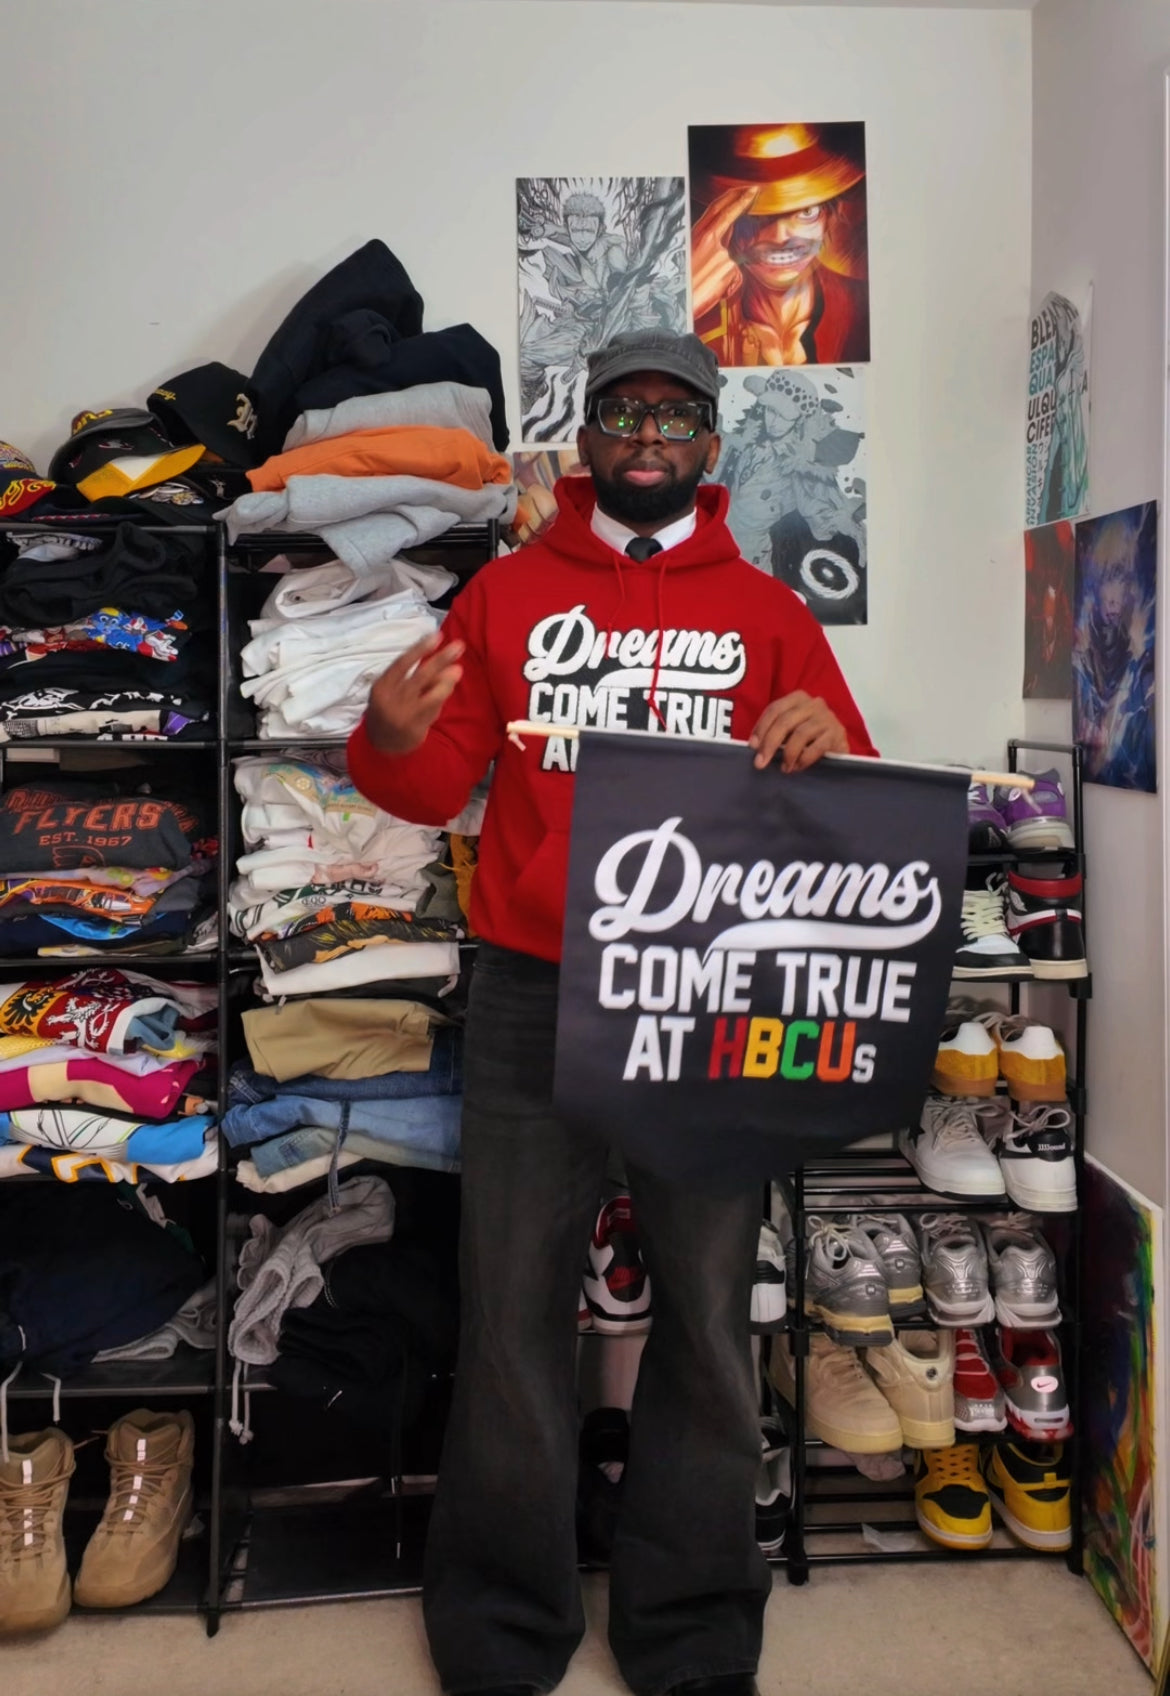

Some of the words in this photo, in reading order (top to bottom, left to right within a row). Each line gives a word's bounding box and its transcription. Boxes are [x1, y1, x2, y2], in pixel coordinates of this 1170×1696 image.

[523, 604, 746, 691] Dreams
[529, 682, 630, 733] COME
[643, 689, 734, 740] TRUE
[12, 802, 166, 836] FLYERS
[39, 831, 79, 847] EST.
[86, 835, 133, 848] 1967
[588, 816, 942, 949] Dreams
[599, 943, 756, 1013] COME
[776, 953, 917, 1023] TRUE
[622, 1015, 696, 1082] AT
[708, 1016, 877, 1083] HBCUs
